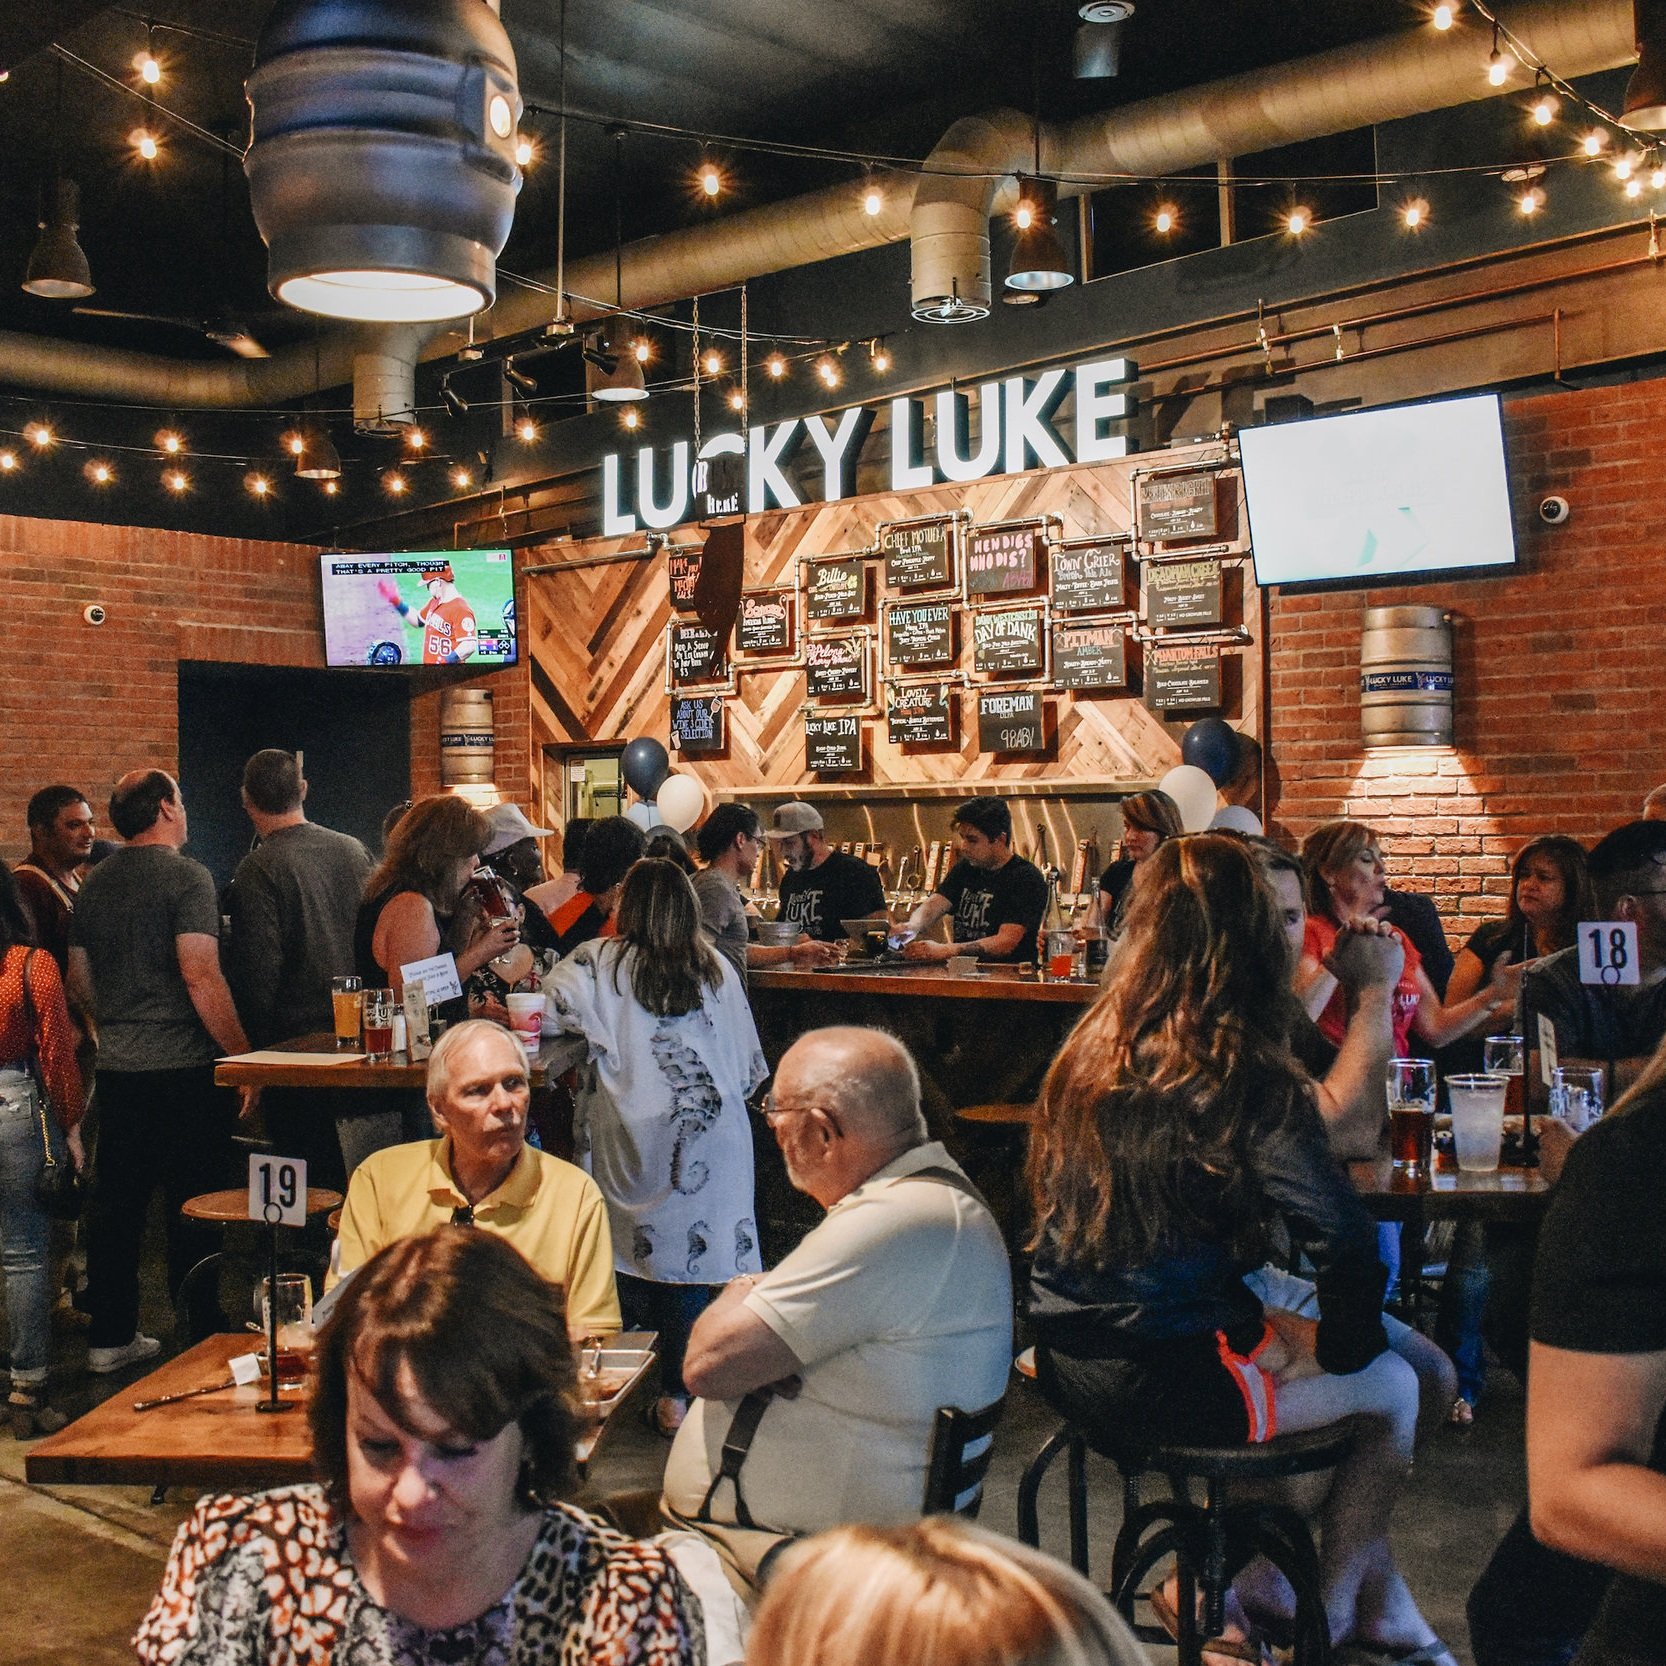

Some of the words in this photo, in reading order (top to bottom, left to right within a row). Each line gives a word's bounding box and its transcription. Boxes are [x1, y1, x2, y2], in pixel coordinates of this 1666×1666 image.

[892, 357, 1127, 490] LUKE
[884, 531, 909, 549] CHIEF
[1002, 533, 1033, 549] DIGS
[970, 553, 993, 572] WHO
[1052, 554, 1082, 572] TOWN
[1084, 549, 1120, 569] CRIER
[816, 567, 847, 586] Billie
[889, 611, 911, 625] HAVE
[911, 609, 927, 623] YOU
[928, 607, 949, 621] EVER
[975, 623, 994, 644] DAY
[995, 622, 1006, 636] OF
[1007, 621, 1037, 642] DANK
[1064, 629, 1114, 648] PITMAN
[429, 635, 451, 656] 56
[674, 643, 687, 652] ADD
[687, 642, 693, 650] A
[1077, 646, 1102, 656] AMBER
[680, 668, 689, 676] $3
[1369, 676, 1391, 685] LUCKY
[1393, 675, 1412, 683] LUKE
[901, 688, 928, 699] LOVELY
[680, 700, 691, 710] ASK
[693, 700, 703, 709] US
[895, 697, 932, 708] CREATURE
[980, 695, 1034, 714] FOREMAN
[676, 709, 694, 719] ABOUT
[695, 708, 708, 719] OUR
[672, 719, 689, 730] WINE
[805, 721, 822, 735] LUCKY
[823, 720, 838, 735] LUKE
[838, 719, 857, 735] IPA
[680, 729, 713, 739] SELECTION
[1588, 928, 1628, 969] 18
[259, 1163, 296, 1208] 19
